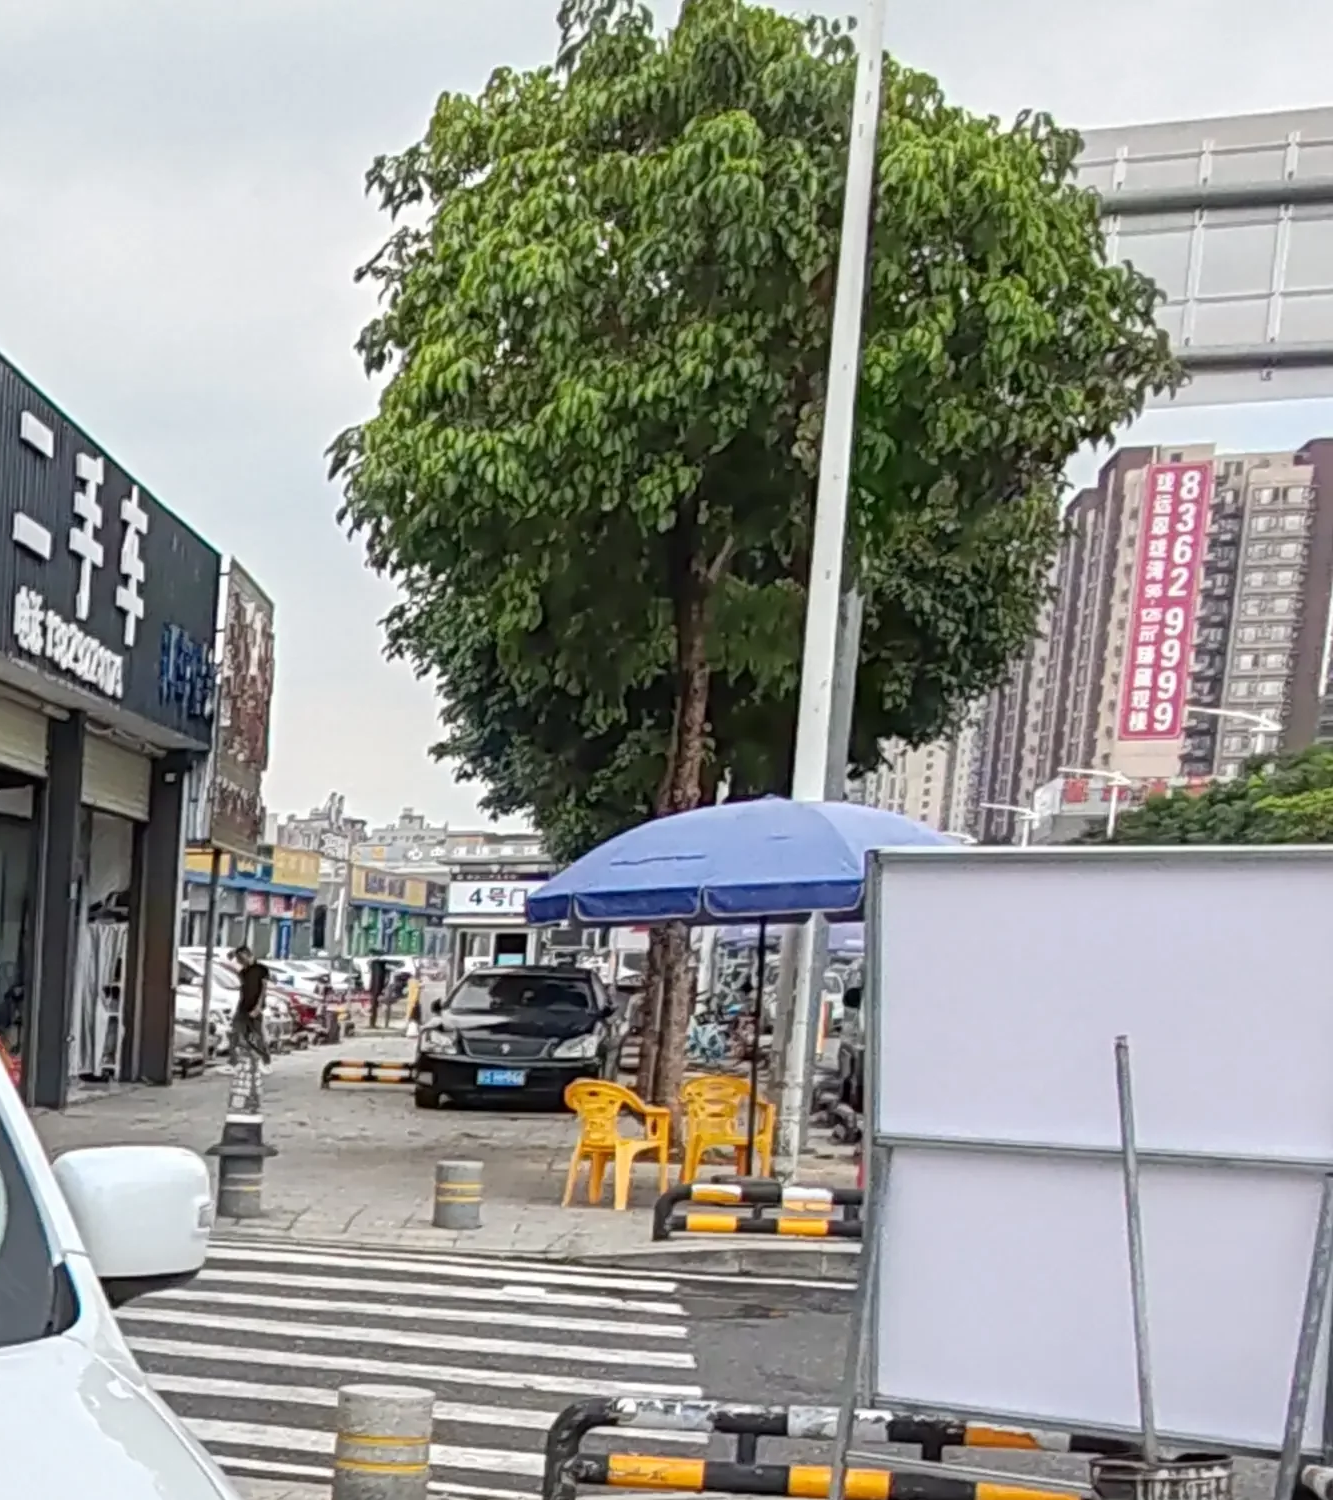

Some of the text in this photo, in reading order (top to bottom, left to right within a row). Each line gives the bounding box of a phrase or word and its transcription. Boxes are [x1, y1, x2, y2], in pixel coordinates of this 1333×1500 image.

[14, 410, 148, 647] 二手车
[468, 886, 529, 908] 4号门
